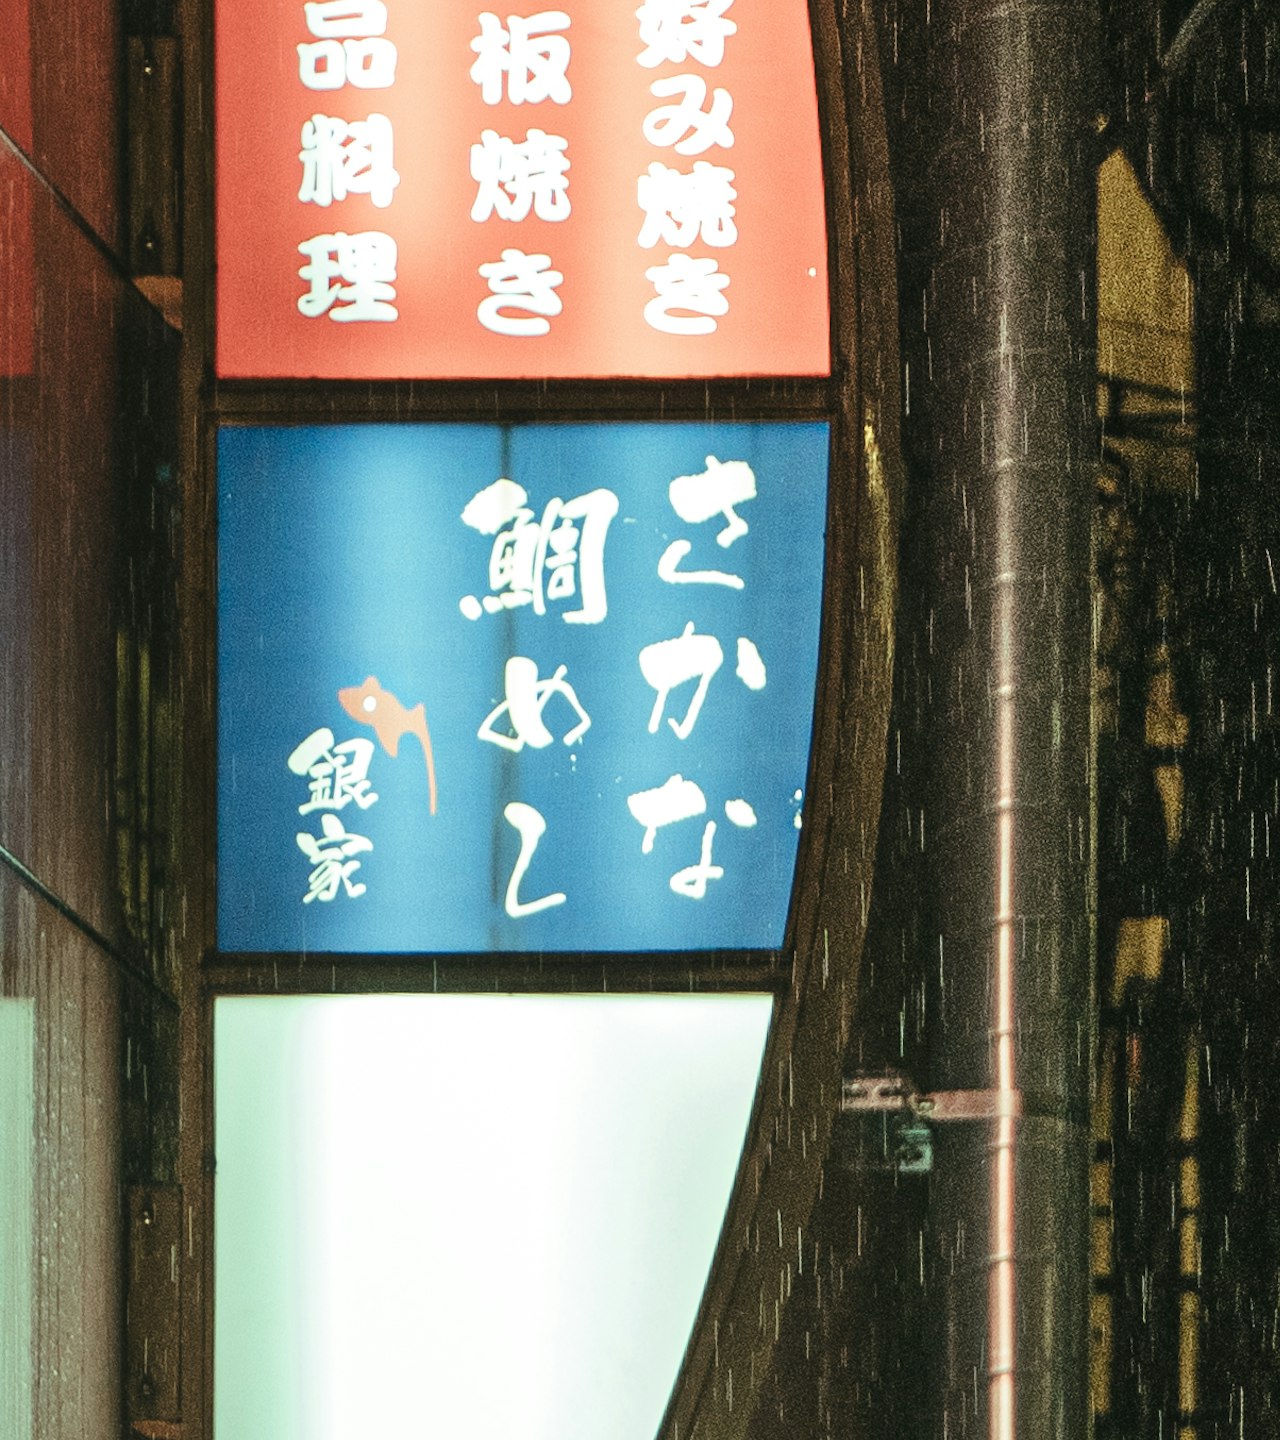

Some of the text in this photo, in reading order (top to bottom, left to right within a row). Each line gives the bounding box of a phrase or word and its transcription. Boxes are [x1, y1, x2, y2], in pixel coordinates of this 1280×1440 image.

[469, 10, 573, 337] 板焼き
[286, 727, 380, 903] 銀家
[459, 479, 619, 917] 鯛めし
[627, 456, 767, 899] さかな
